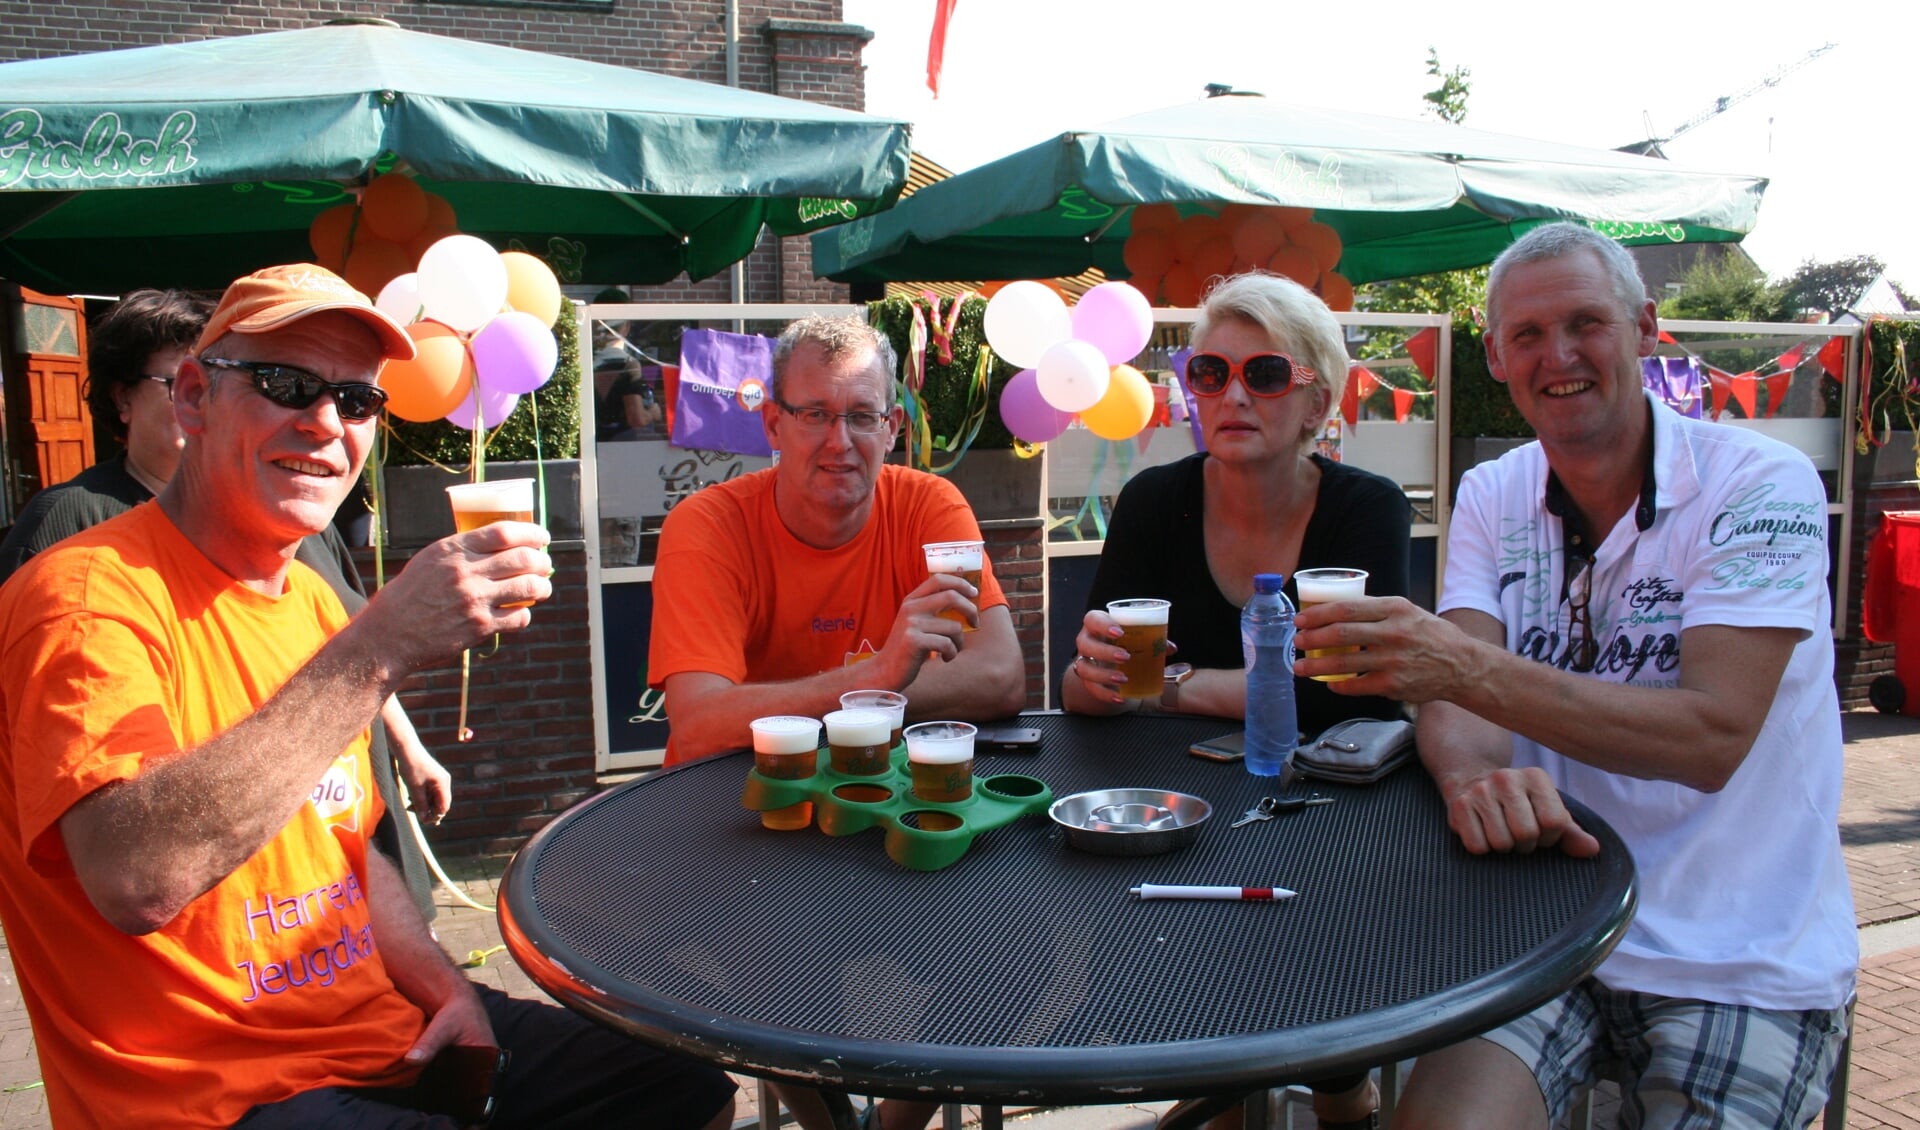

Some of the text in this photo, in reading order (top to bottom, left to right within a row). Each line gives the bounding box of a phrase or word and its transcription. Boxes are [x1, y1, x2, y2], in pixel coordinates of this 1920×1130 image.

[1206, 143, 1344, 200] Glsch
[691, 383, 762, 401] omroep gld
[1724, 483, 1820, 528] Grand
[811, 611, 857, 632] René
[1628, 610, 1665, 628] Grade
[312, 777, 346, 807] gld
